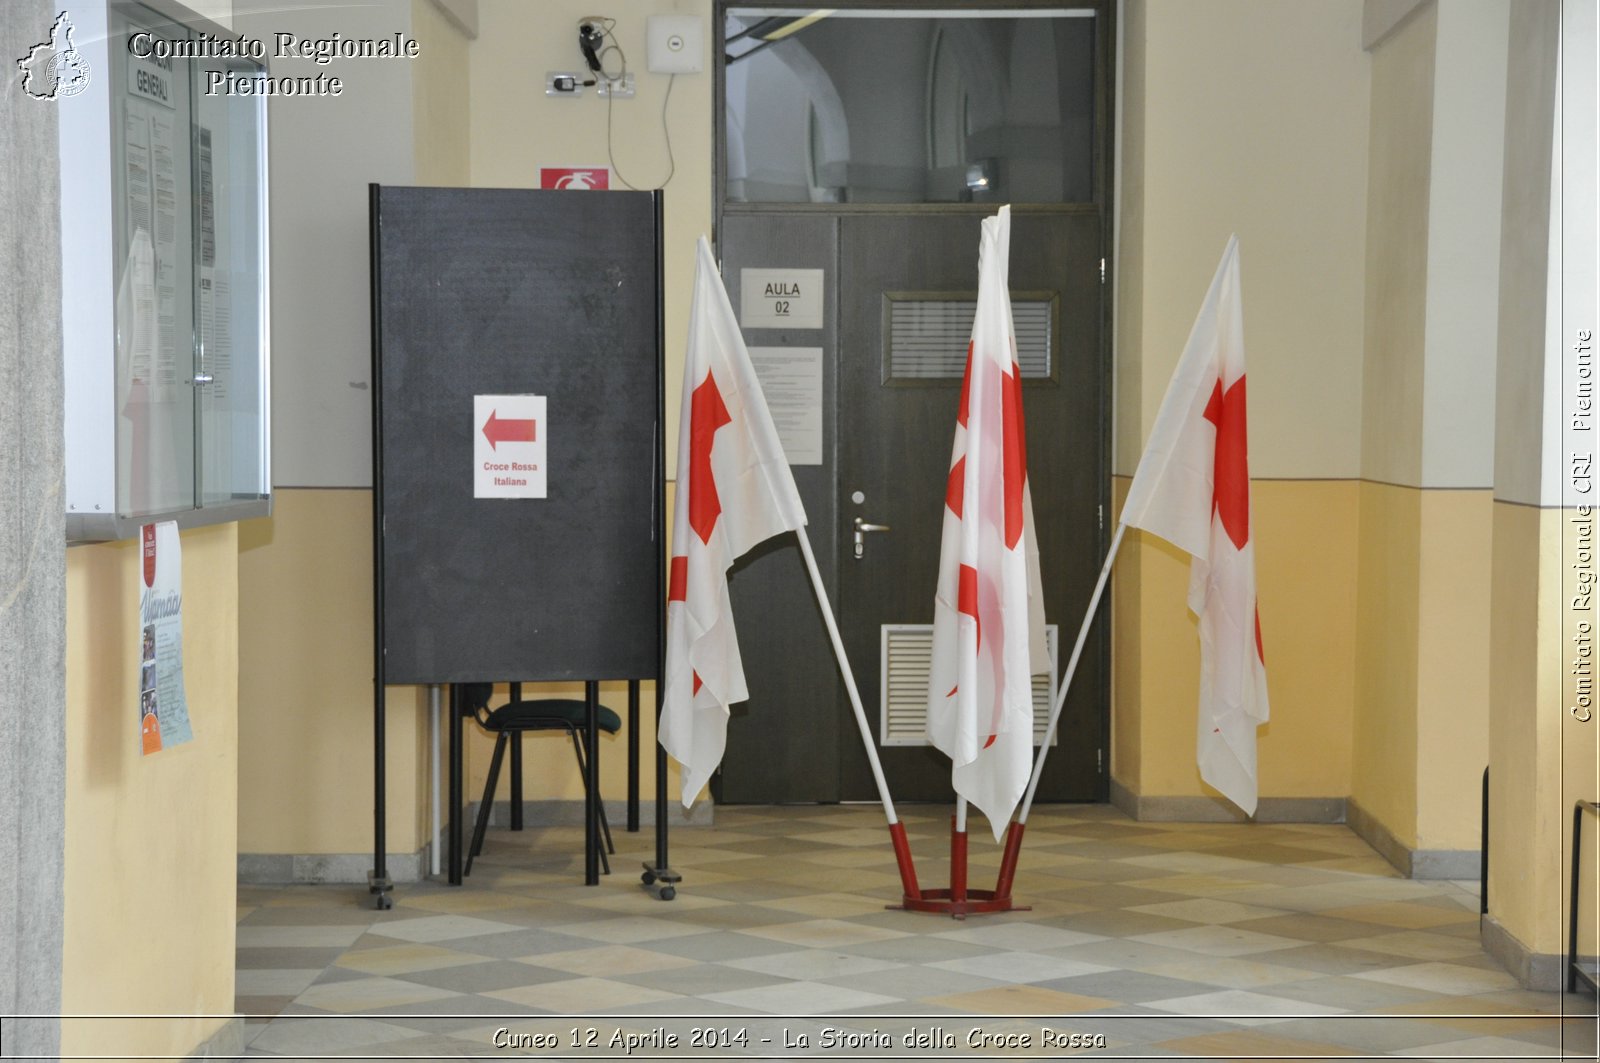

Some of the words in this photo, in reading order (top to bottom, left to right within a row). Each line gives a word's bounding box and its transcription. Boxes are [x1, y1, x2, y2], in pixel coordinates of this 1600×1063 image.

[136, 68, 168, 102] GENERALI
[764, 282, 801, 296] AULA
[775, 300, 790, 314] 02
[483, 461, 510, 472] Croce
[511, 461, 538, 472] Rossa
[494, 476, 528, 487] Italiana
